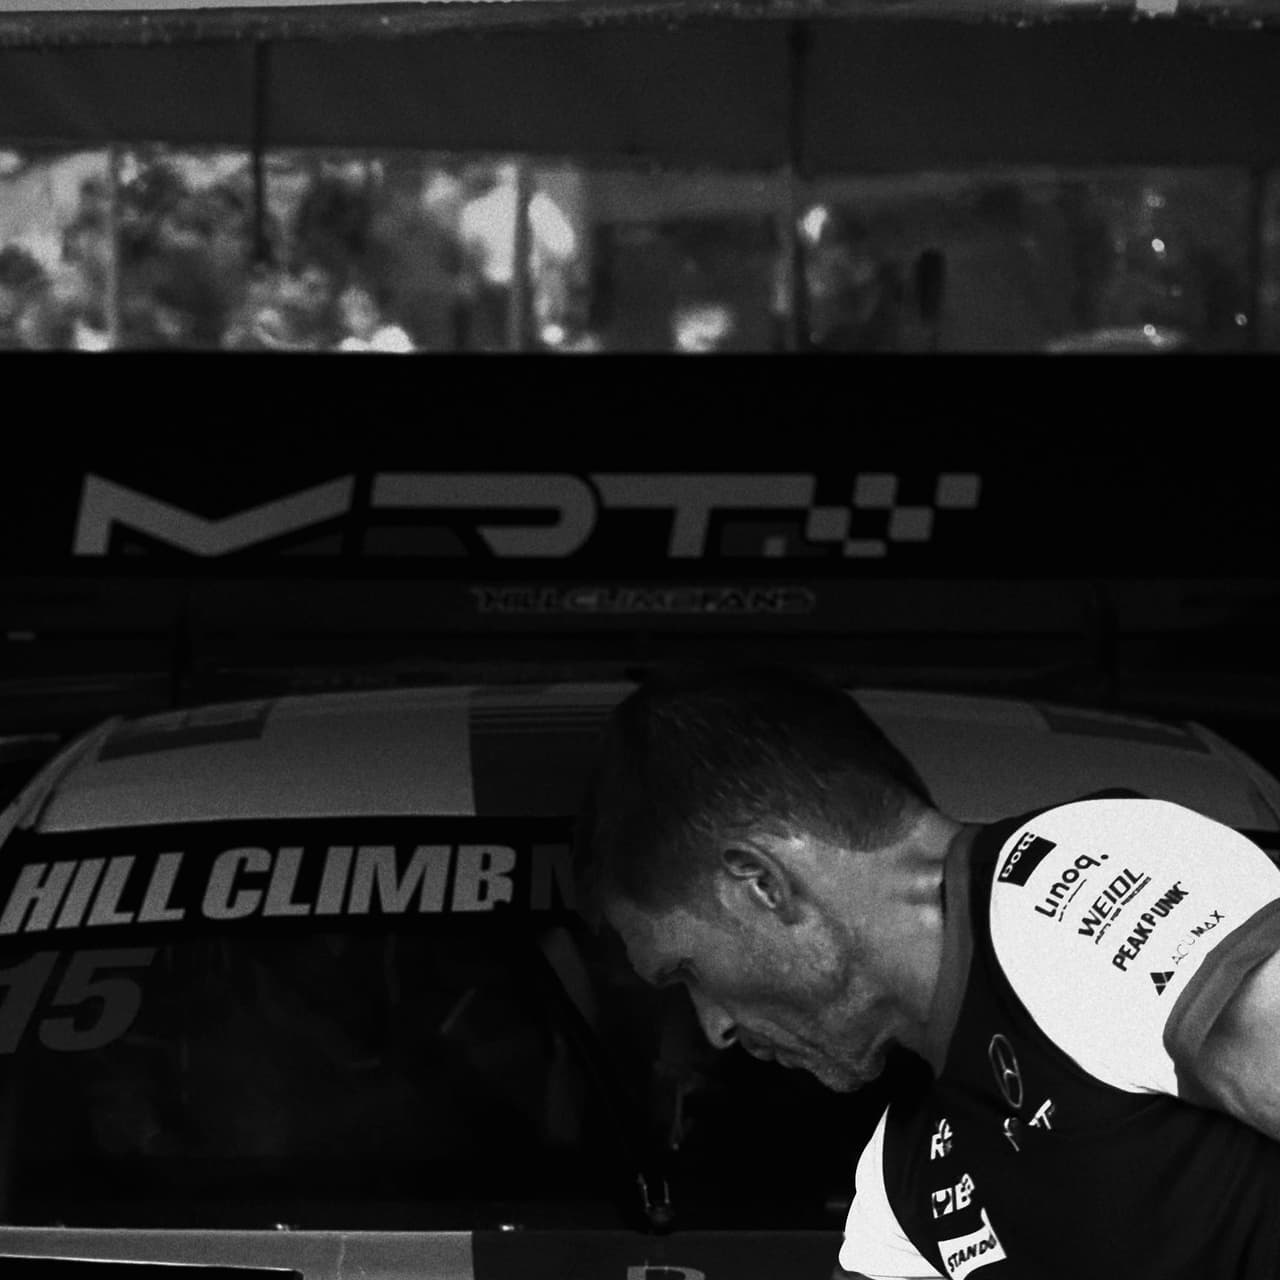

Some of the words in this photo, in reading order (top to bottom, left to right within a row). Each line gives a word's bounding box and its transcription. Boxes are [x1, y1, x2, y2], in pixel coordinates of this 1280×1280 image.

[199, 842, 519, 921] CLIMB
[1077, 868, 1144, 937] WEIDL
[1112, 922, 1153, 972] PEAK
